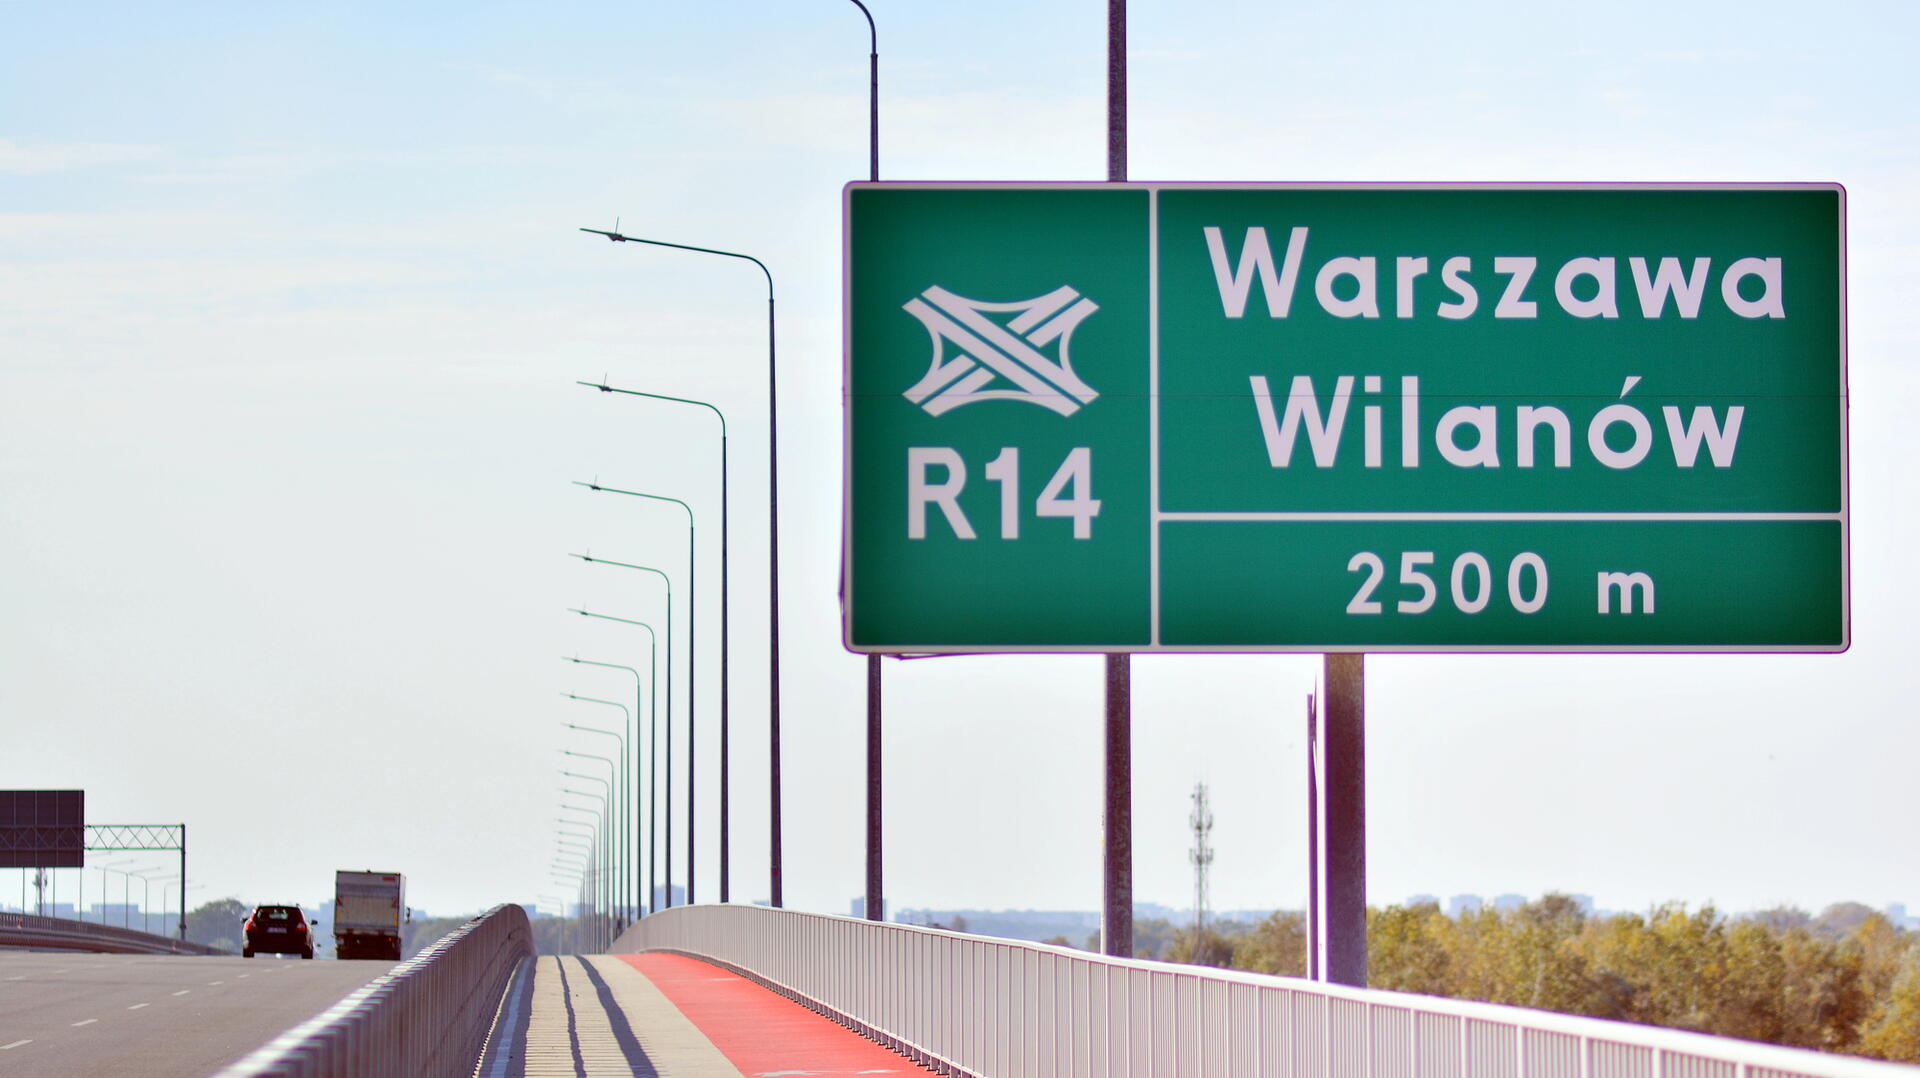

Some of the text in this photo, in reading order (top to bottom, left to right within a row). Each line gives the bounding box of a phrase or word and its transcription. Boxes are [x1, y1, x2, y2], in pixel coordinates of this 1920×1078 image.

[1203, 226, 1786, 320] Warszawa
[1249, 375, 1745, 470] Wilanów
[908, 447, 1102, 540] R14
[1346, 551, 1656, 614] 2500 m
